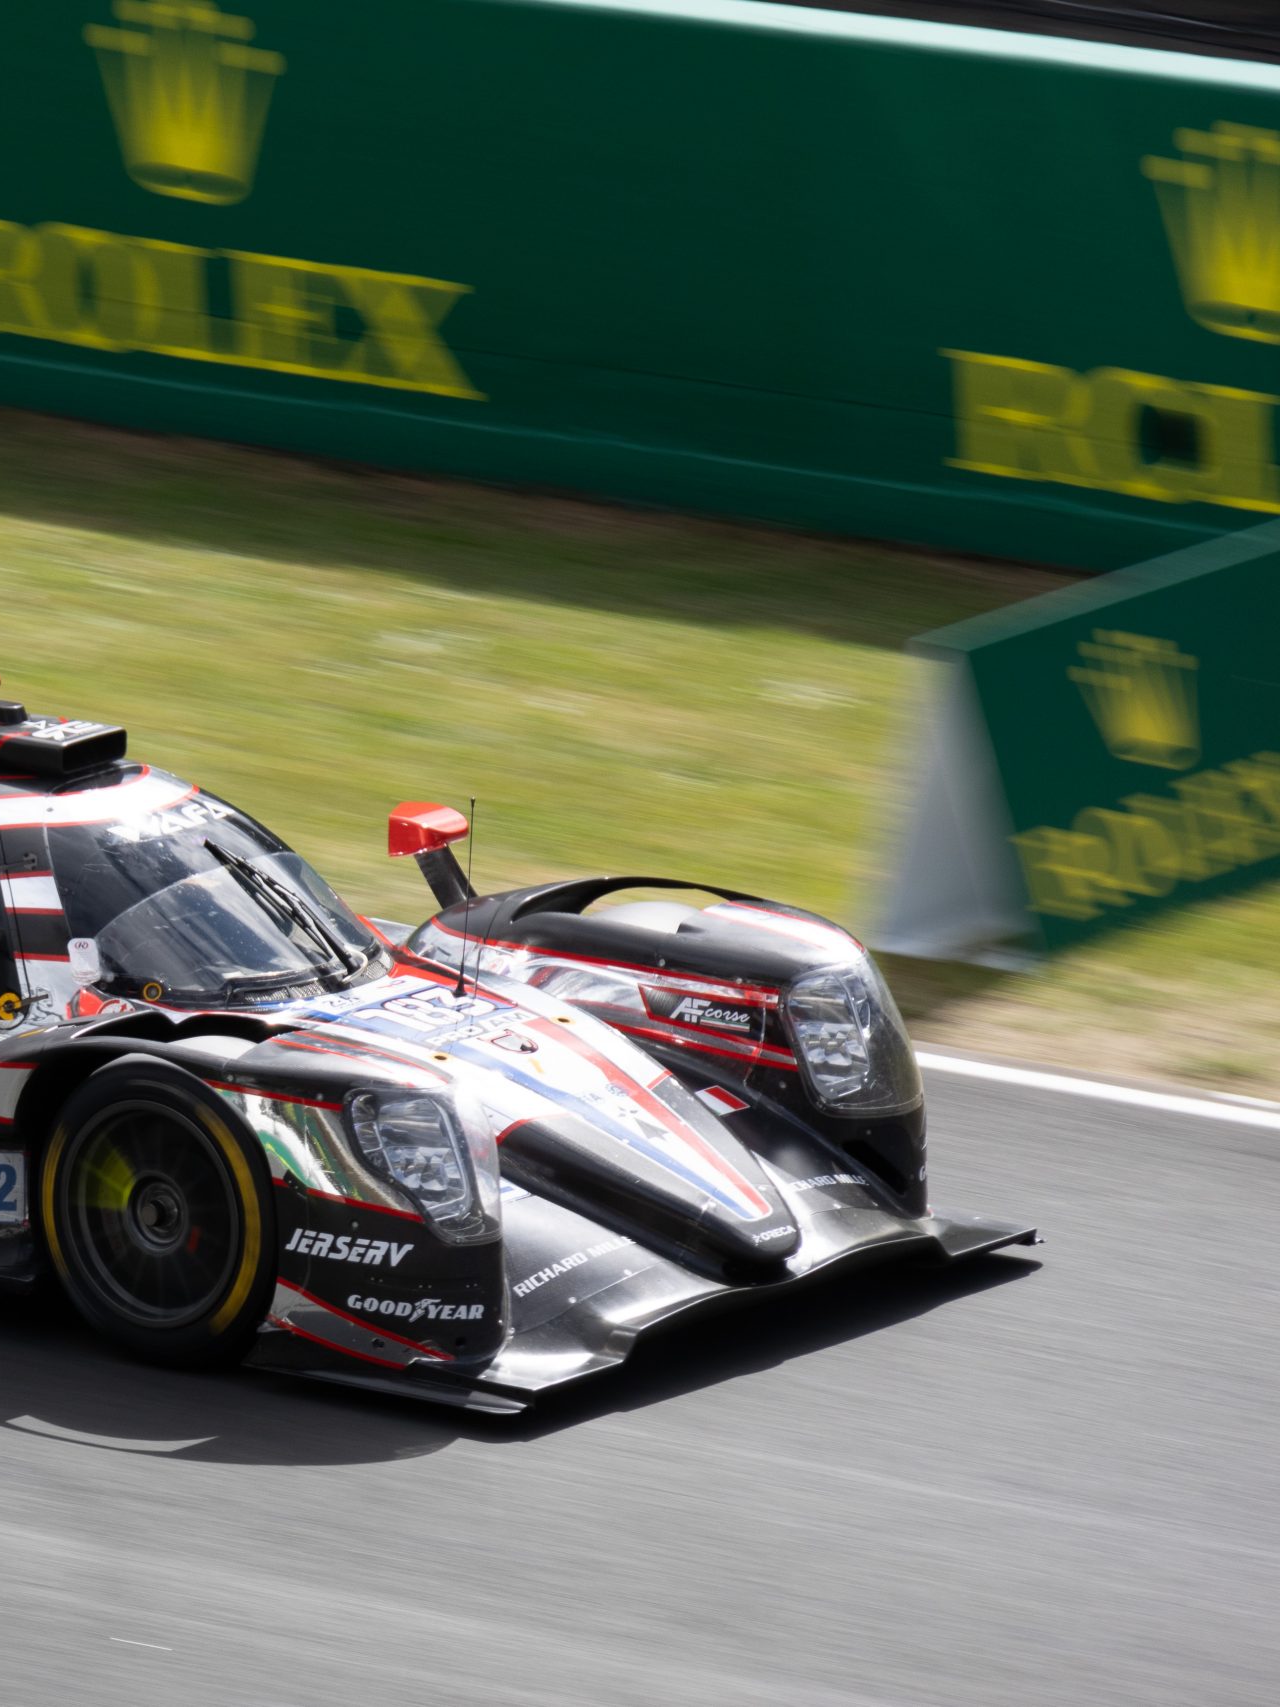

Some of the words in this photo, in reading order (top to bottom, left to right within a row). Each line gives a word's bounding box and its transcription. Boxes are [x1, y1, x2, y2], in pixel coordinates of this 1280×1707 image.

[937, 347, 1280, 514] ROL
[704, 1007, 751, 1023] corse
[284, 1227, 415, 1267] JERSERV
[761, 1224, 796, 1242] ORECA
[512, 1252, 588, 1298] RICHARD
[347, 1294, 485, 1323] GOODYEAR
